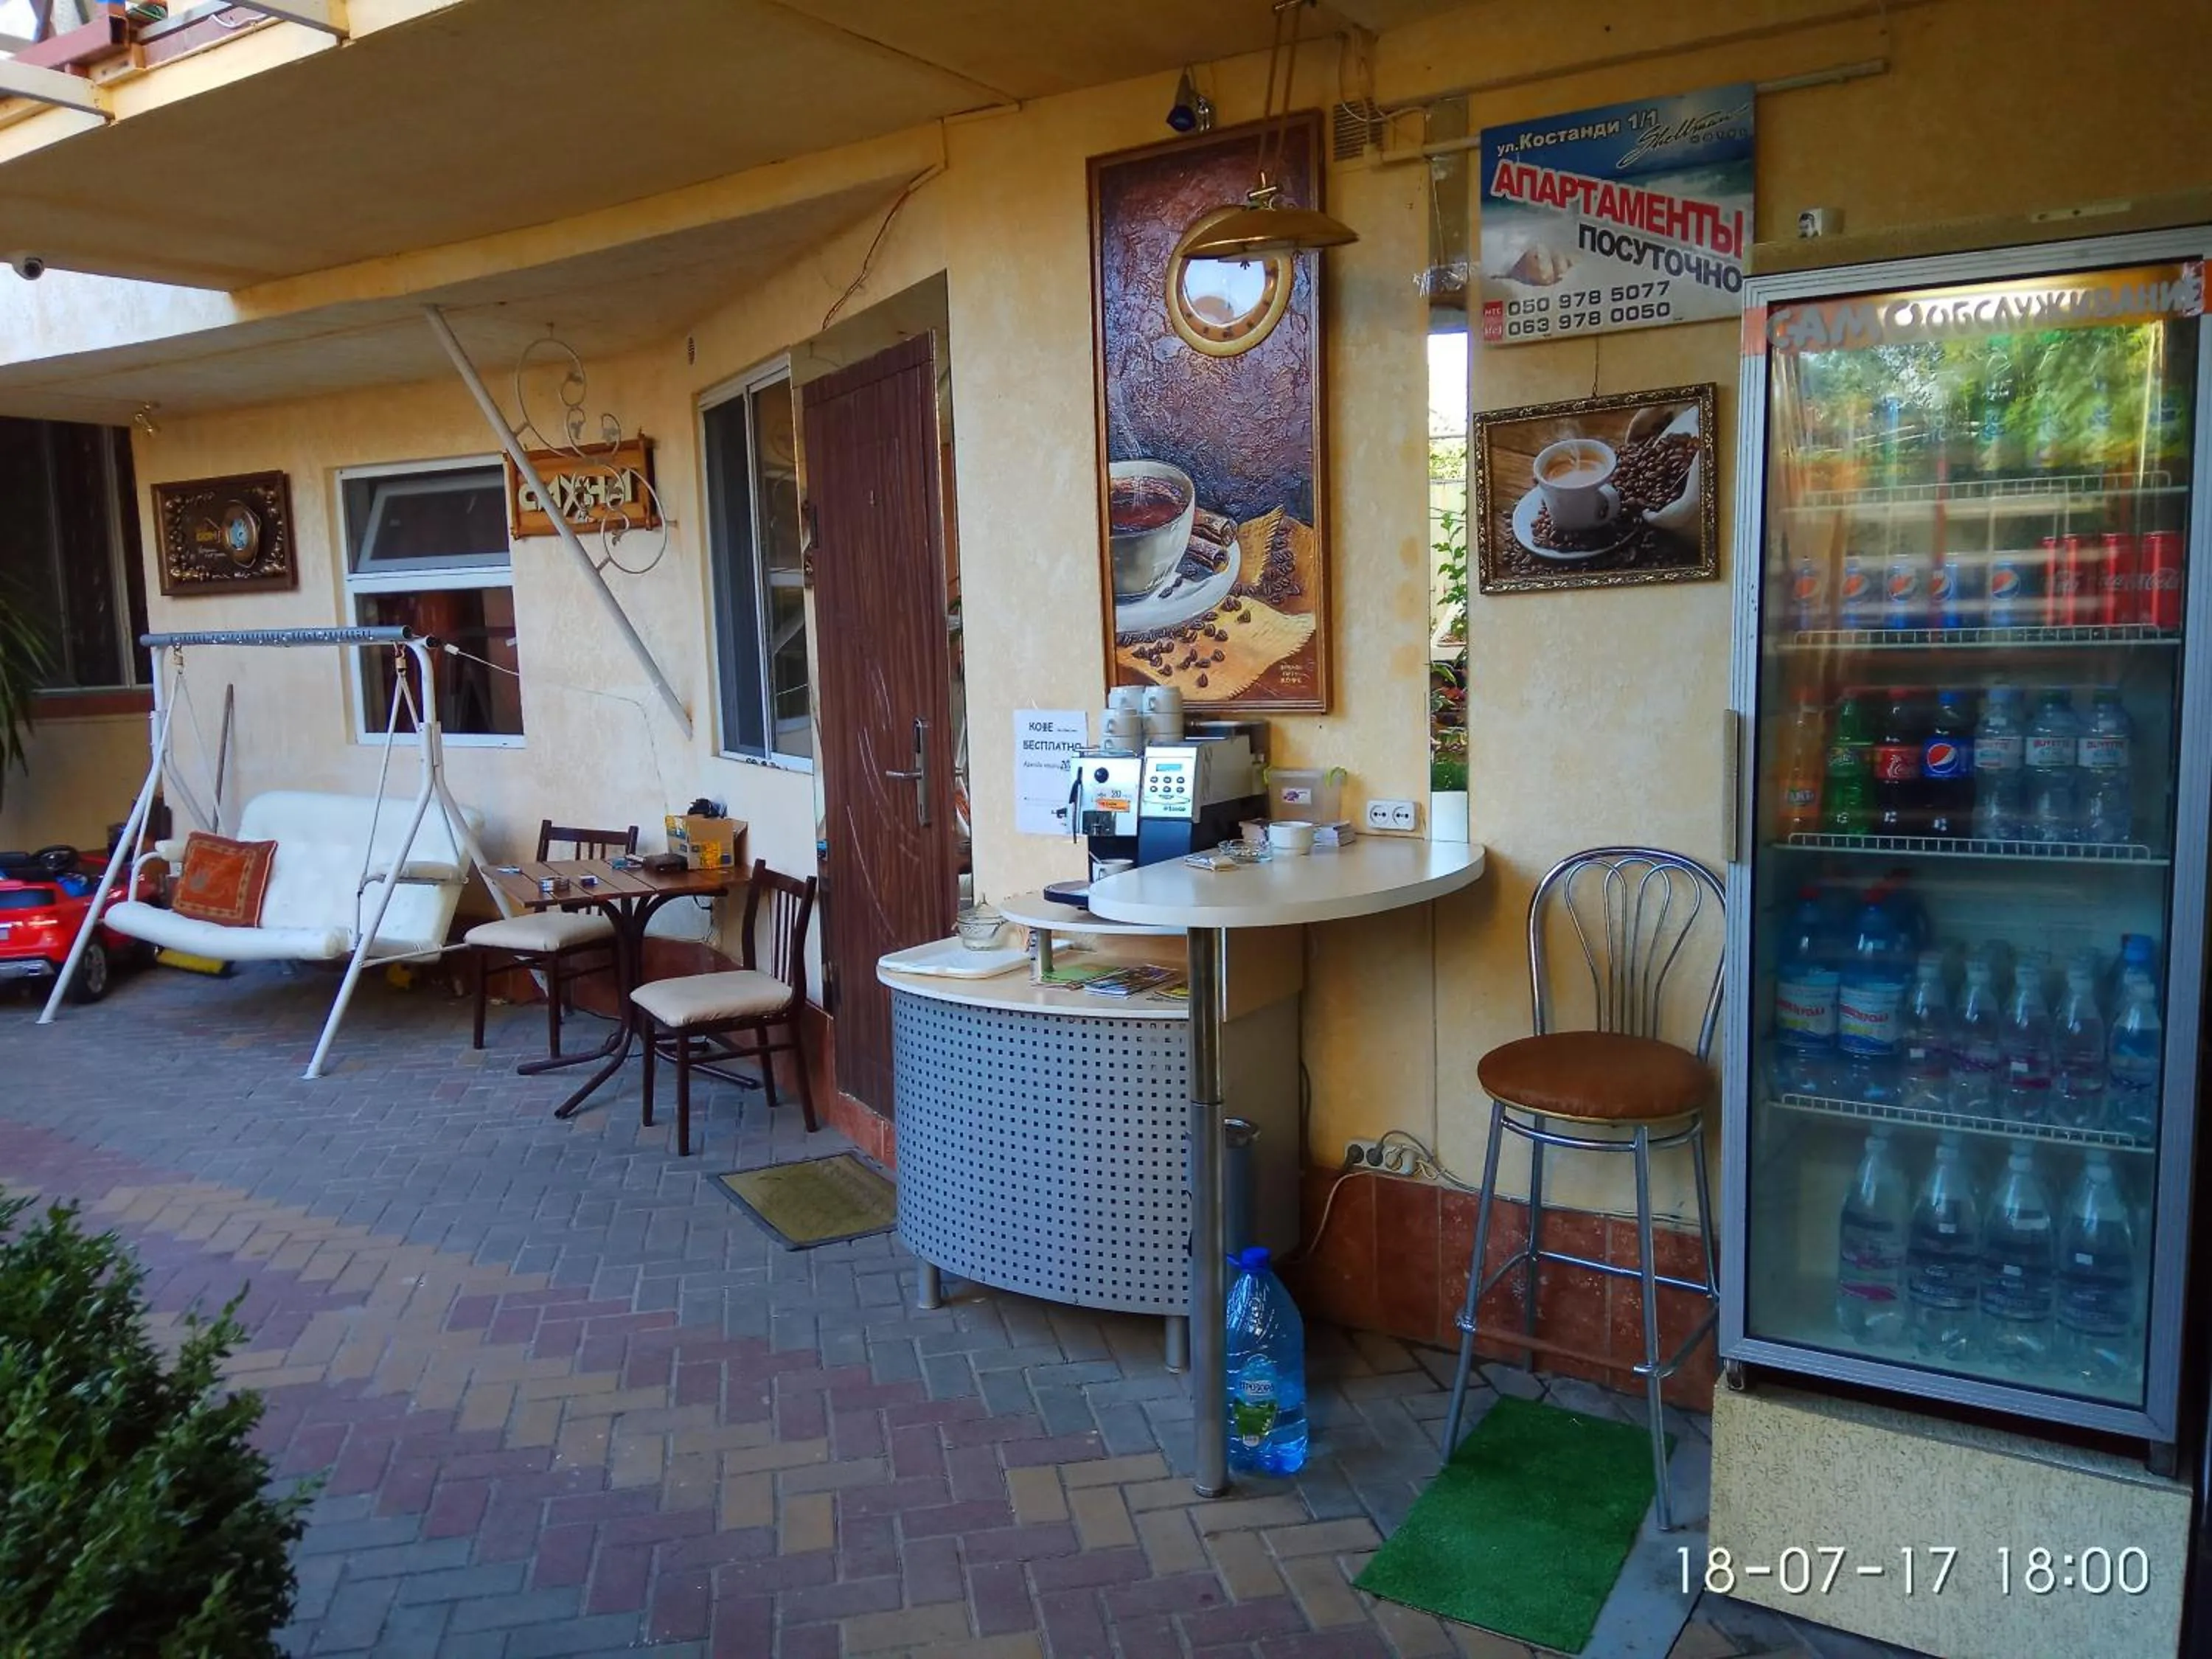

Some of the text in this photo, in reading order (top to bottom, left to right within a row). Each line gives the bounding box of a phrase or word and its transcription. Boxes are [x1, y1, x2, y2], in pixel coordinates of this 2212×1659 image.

[1627, 109, 1659, 130] 1/1
[1491, 160, 1744, 260] АПАРТАМЕНТЫ
[1578, 223, 1743, 293] ПОСУТОЧНО
[1508, 279, 1672, 316] 050 978 5077
[1508, 302, 1671, 336] 063 978 0050
[1023, 740, 1082, 752] БЕСПЛАТНО
